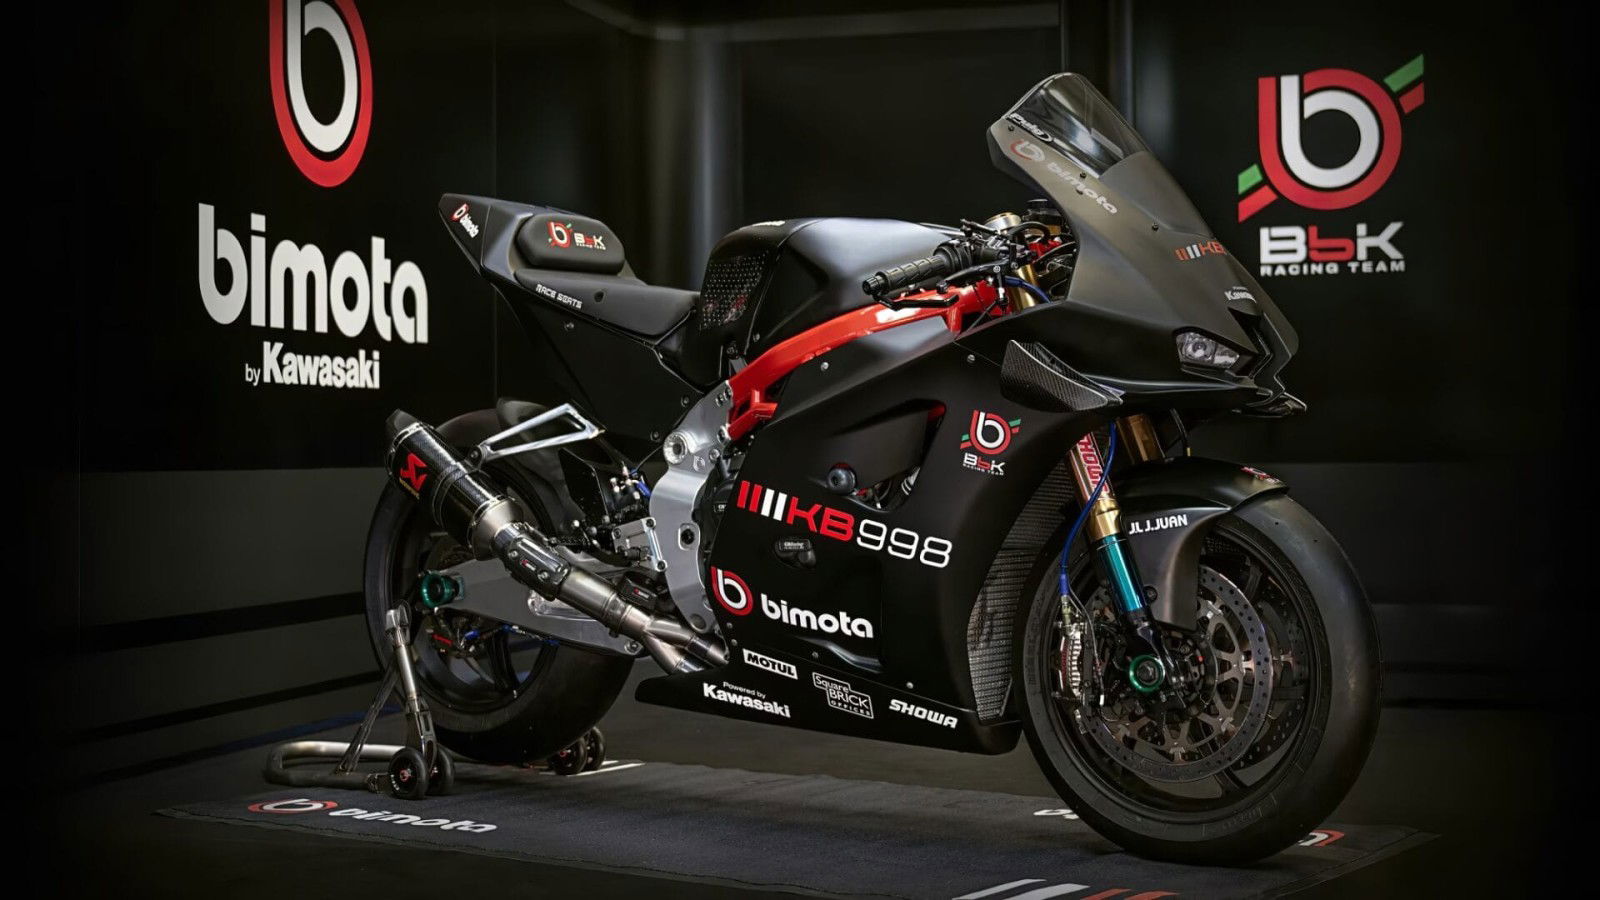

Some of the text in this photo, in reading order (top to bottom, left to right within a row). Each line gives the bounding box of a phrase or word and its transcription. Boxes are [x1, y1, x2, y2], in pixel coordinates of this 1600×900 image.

[1047, 162, 1118, 213] bimota
[1260, 221, 1404, 264] BbK
[198, 203, 429, 344] bimota
[1260, 260, 1406, 277] RACING TEAM
[536, 283, 557, 299] RACE
[245, 341, 380, 389] by Kawasaki
[1077, 433, 1110, 493] HOW
[786, 496, 953, 568] KB998
[1144, 514, 1188, 532] J.JUAN
[761, 593, 874, 639] bimota
[747, 653, 795, 677] MOTUL
[723, 681, 766, 700] Powered by
[815, 675, 850, 693] Square
[703, 682, 791, 718] Kawasaki
[830, 700, 871, 716] OFFICES
[889, 698, 959, 729] SHOWA
[328, 808, 498, 833] bimota
